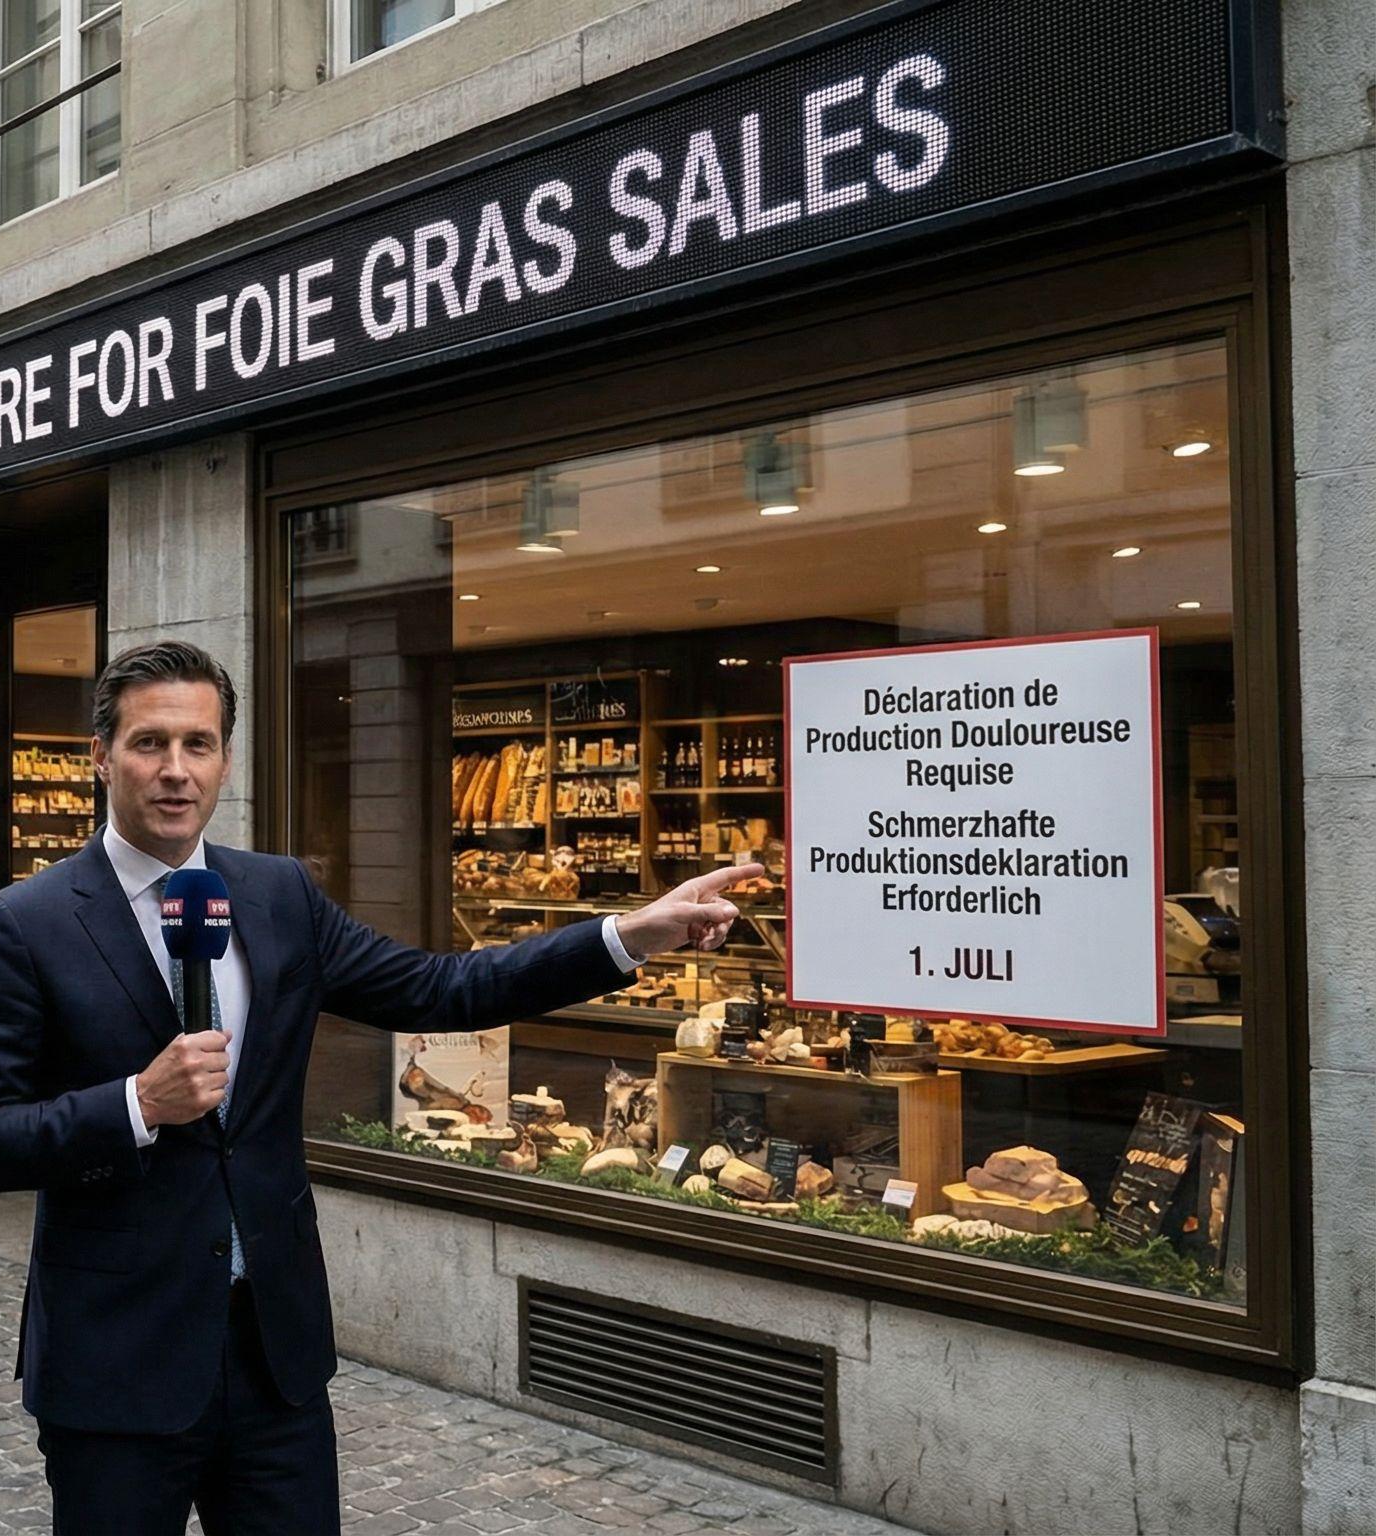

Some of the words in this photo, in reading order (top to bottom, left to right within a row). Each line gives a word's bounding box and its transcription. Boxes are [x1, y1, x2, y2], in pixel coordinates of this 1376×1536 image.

[69, 317, 174, 428] FOR
[196, 259, 335, 392] FOIE
[359, 179, 576, 340] GRAS
[610, 54, 948, 269] SALES
[865, 682, 1014, 715] Déclaration
[1025, 679, 1057, 707] de
[807, 723, 941, 753] Production
[952, 719, 1130, 747] Douloureuse
[907, 757, 1013, 792] Requise
[869, 809, 1055, 838] Schmerzhafte
[811, 847, 1128, 877] Produktionsdeklaration
[883, 884, 1040, 915] Erforderlich
[910, 946, 933, 976] 1.
[945, 948, 1012, 981] JULI
